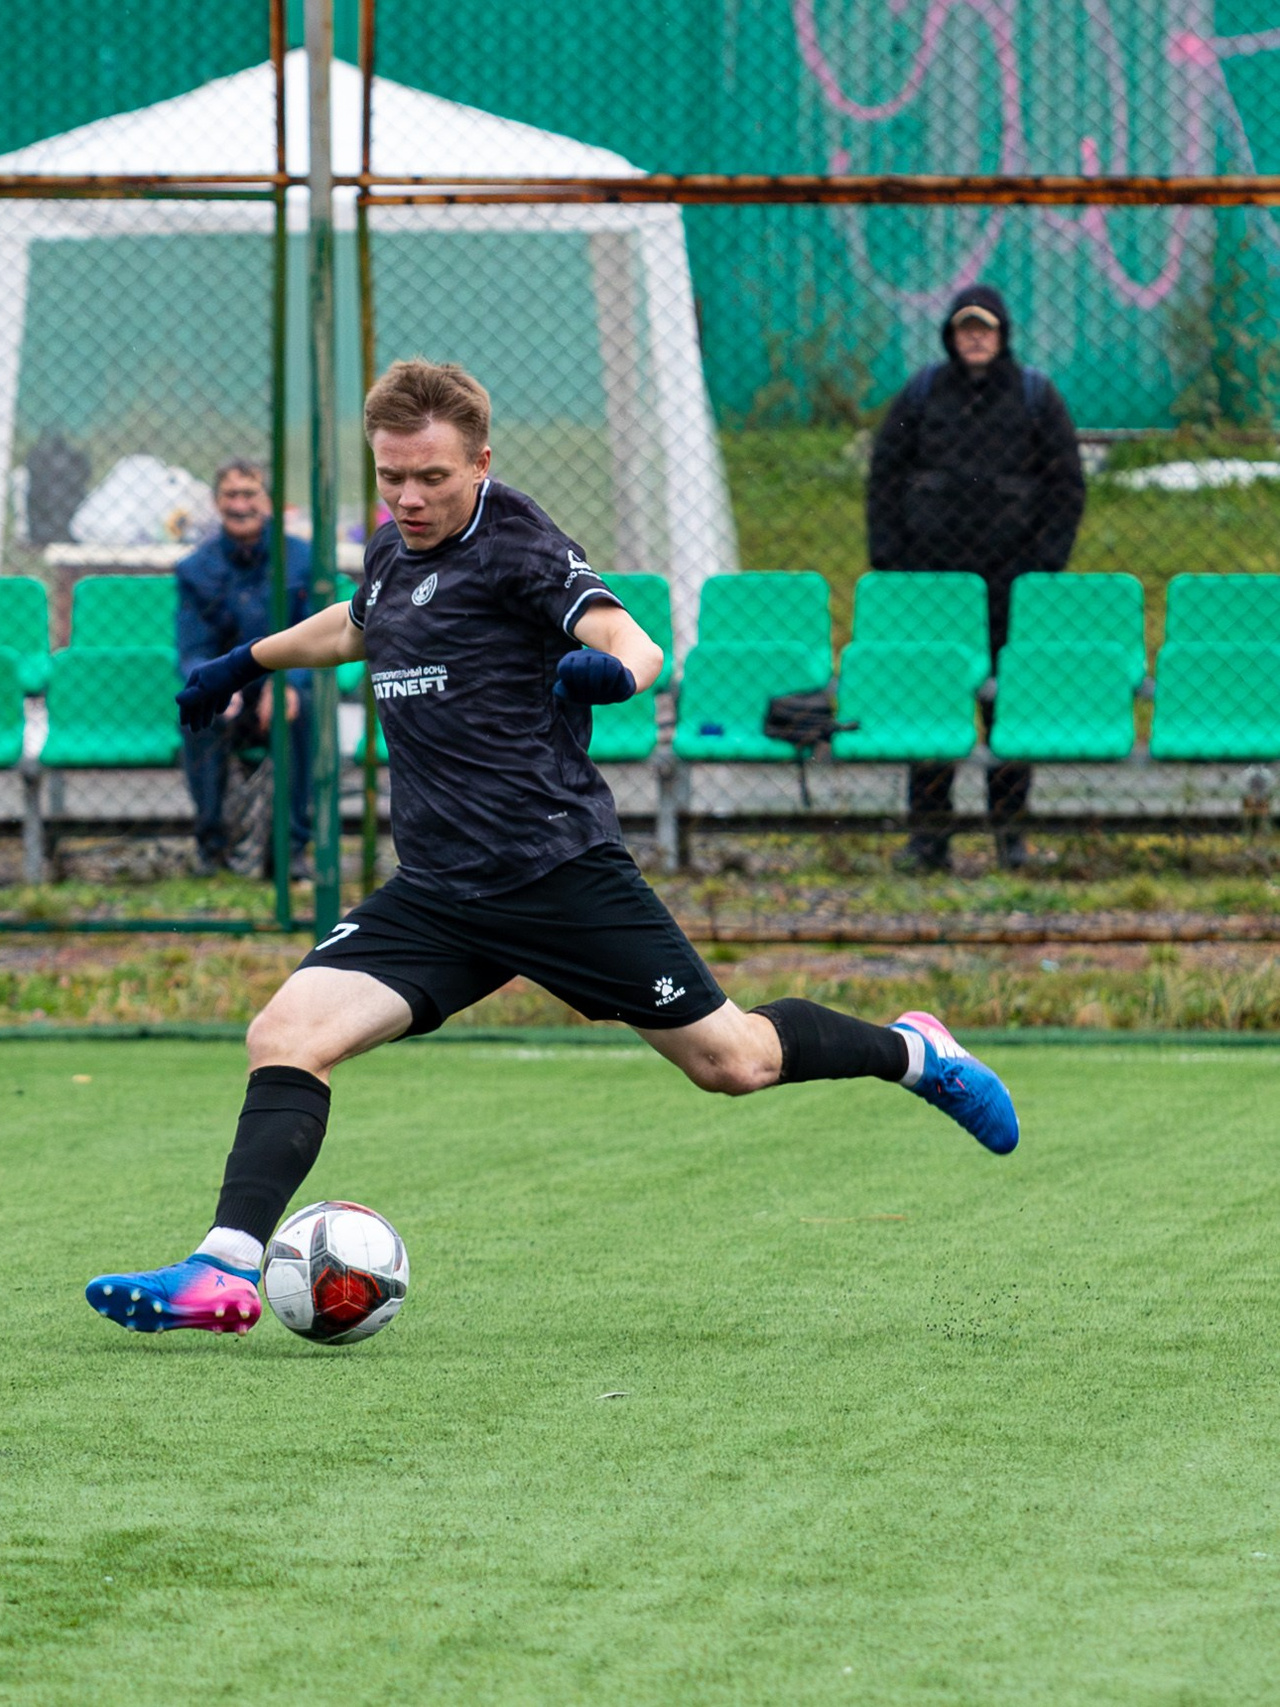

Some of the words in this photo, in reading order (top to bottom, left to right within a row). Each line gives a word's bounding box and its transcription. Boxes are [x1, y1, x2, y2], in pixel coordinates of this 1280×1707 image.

[423, 664, 447, 675] ФОНД
[314, 922, 360, 951] 7
[655, 986, 686, 1007] KELME
